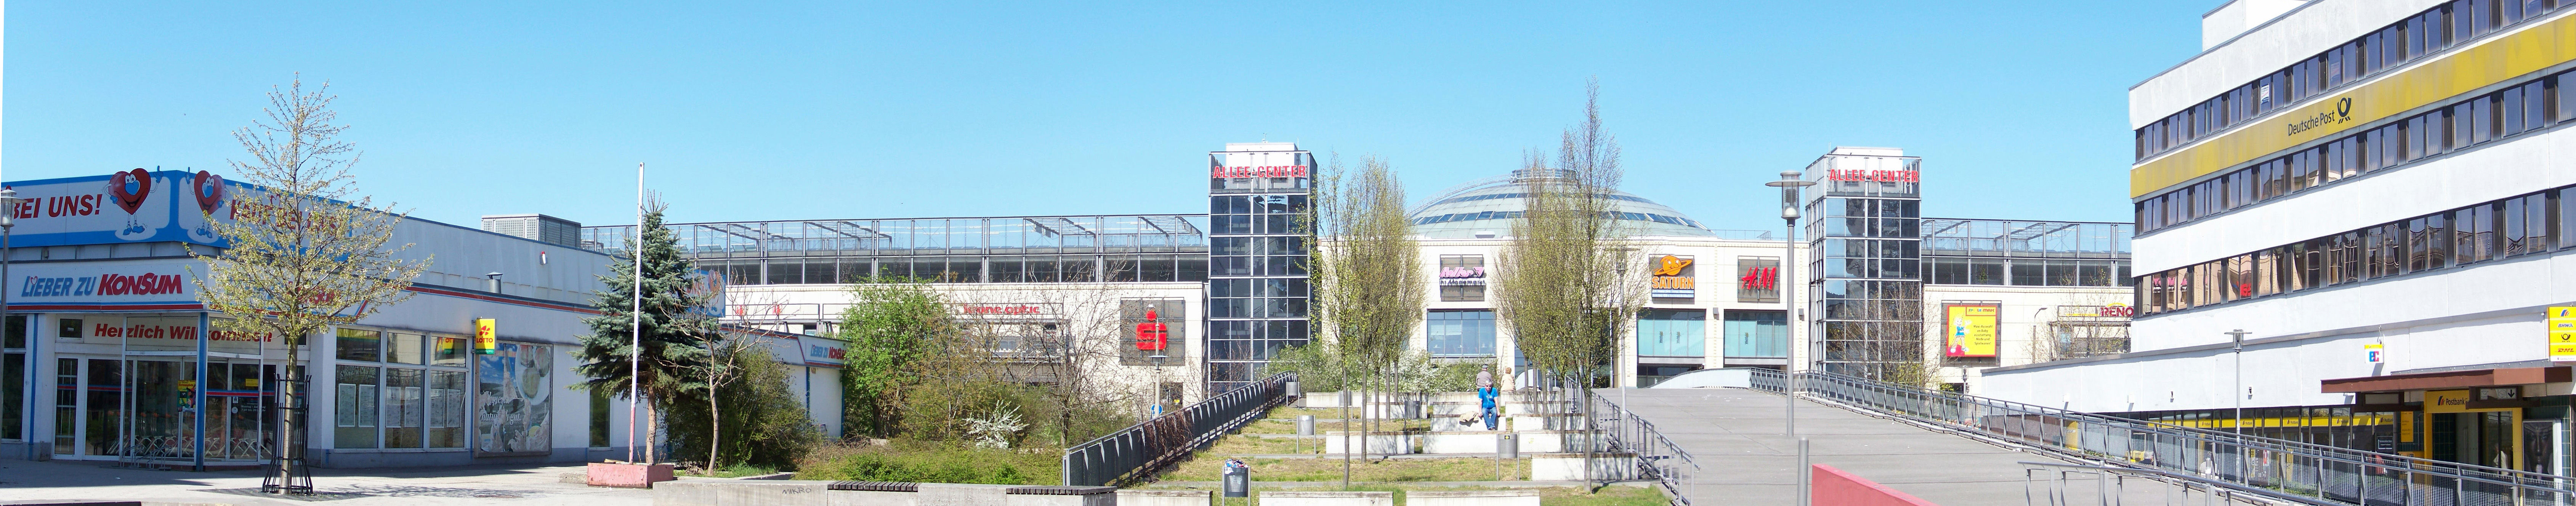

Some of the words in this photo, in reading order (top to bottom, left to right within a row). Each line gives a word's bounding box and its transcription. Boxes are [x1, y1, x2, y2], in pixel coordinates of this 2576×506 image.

[2288, 116, 2318, 136] Deutsche
[2320, 109, 2335, 126] Post
[1213, 165, 1306, 178] ALLEE-CENTER
[1829, 168, 1919, 183] ALLEE-CENTER
[48, 194, 103, 217] UNS!
[1439, 267, 1474, 278] Adler
[1741, 266, 1776, 290] H&M
[21, 275, 74, 297] LIEBER
[74, 276, 97, 295] ZU
[97, 273, 183, 296] KONSUM
[1652, 276, 1694, 289] SATURN
[2100, 307, 2135, 317] RENO
[95, 323, 164, 339] Herzlich
[510, 413, 521, 425] gut.
